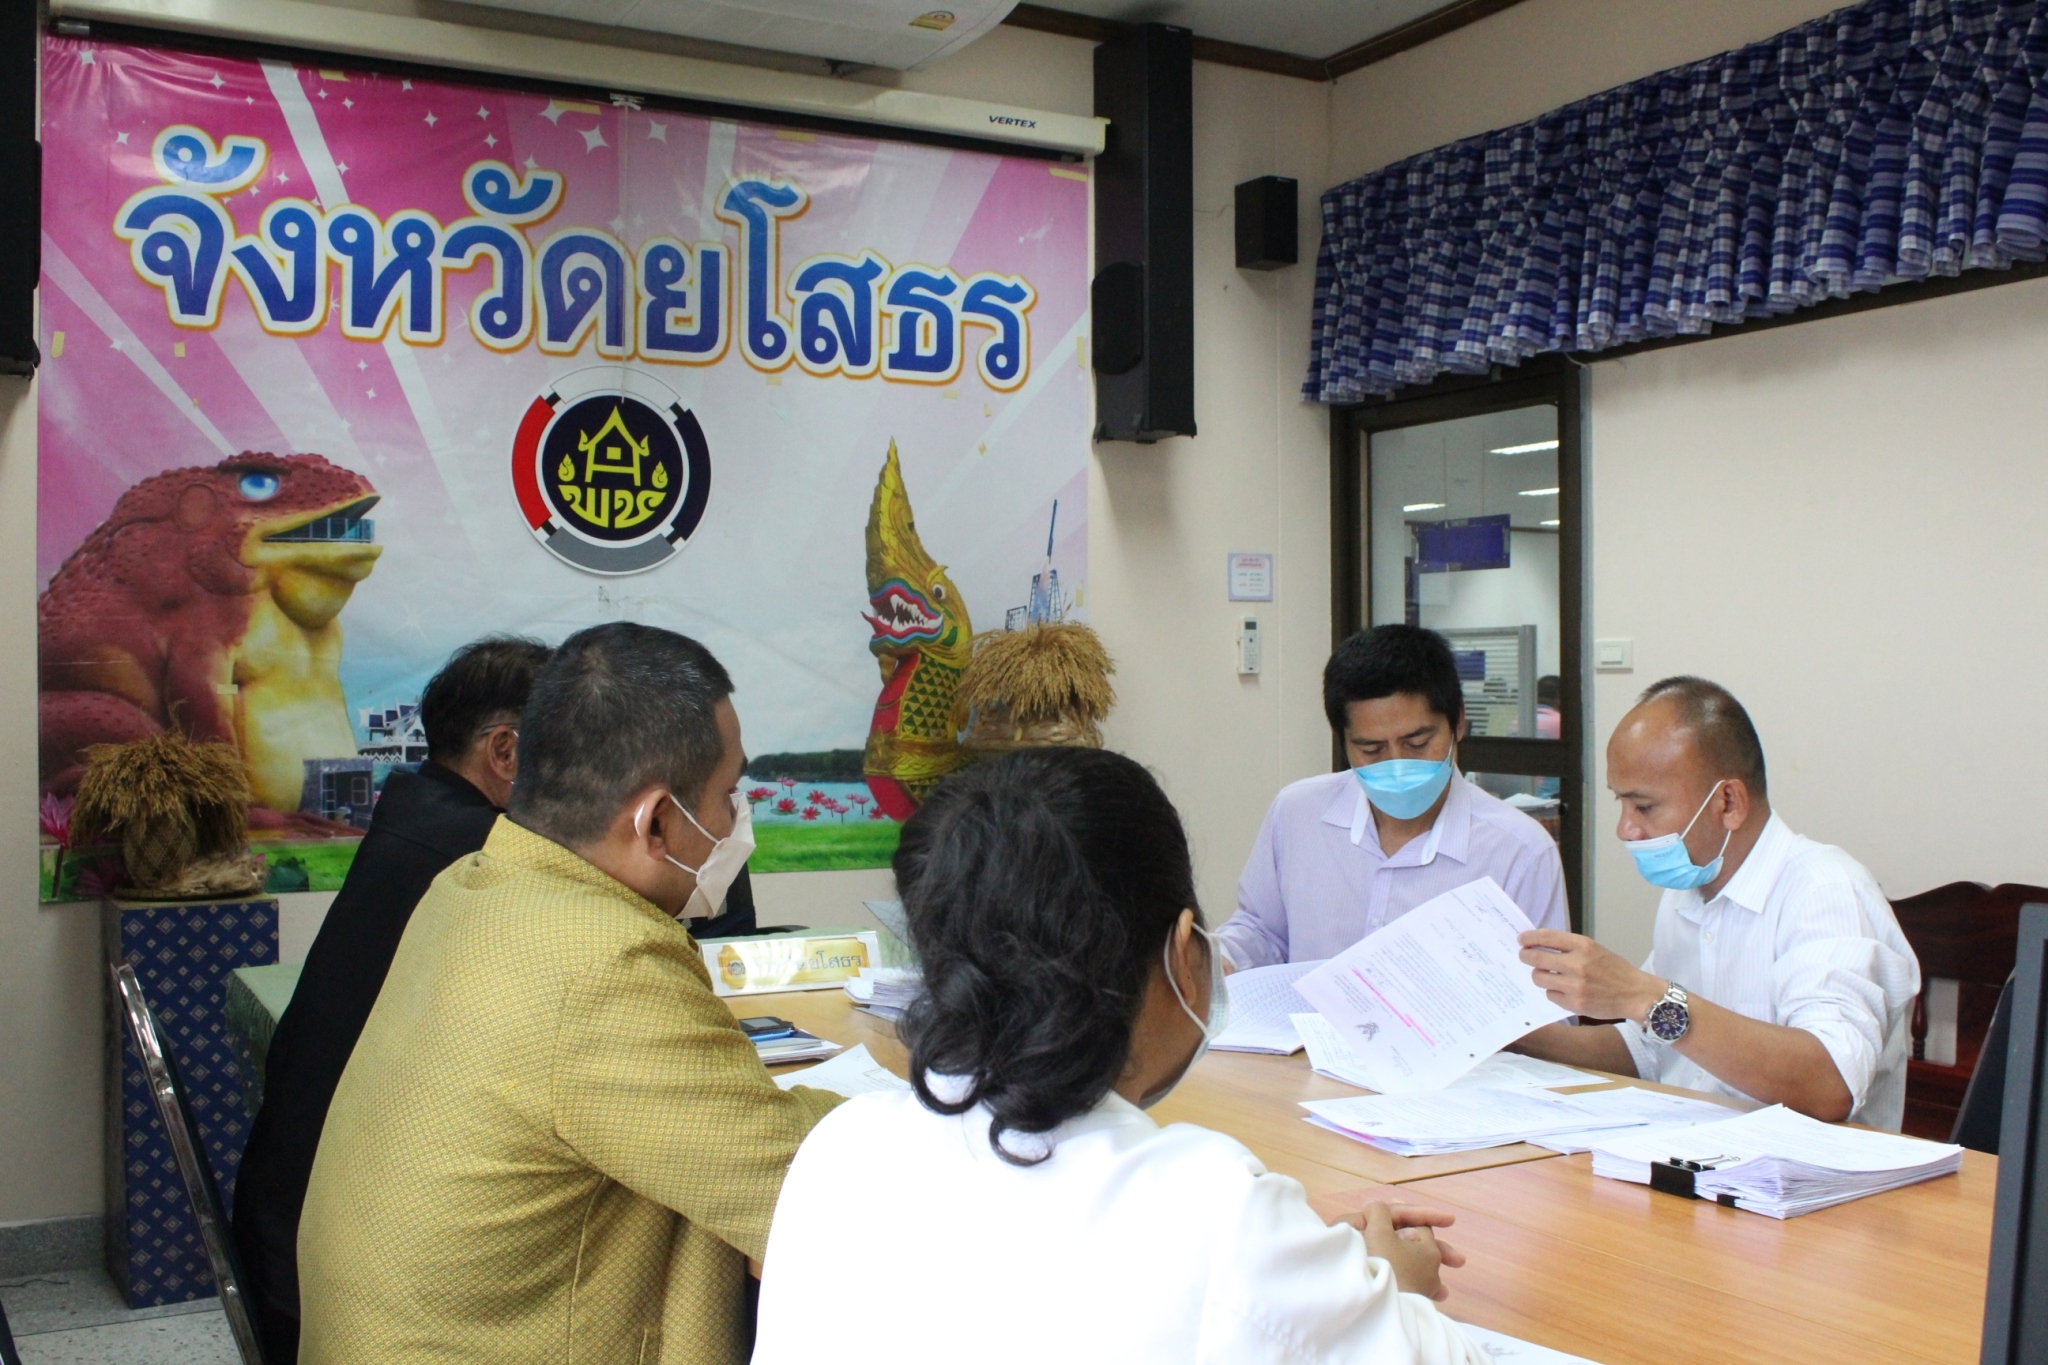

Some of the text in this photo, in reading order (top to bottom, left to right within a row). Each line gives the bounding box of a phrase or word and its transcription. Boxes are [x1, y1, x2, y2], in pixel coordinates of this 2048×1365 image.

[988, 114, 1037, 129] VERTEX
[116, 130, 1032, 388] จังหวัดยโสธร
